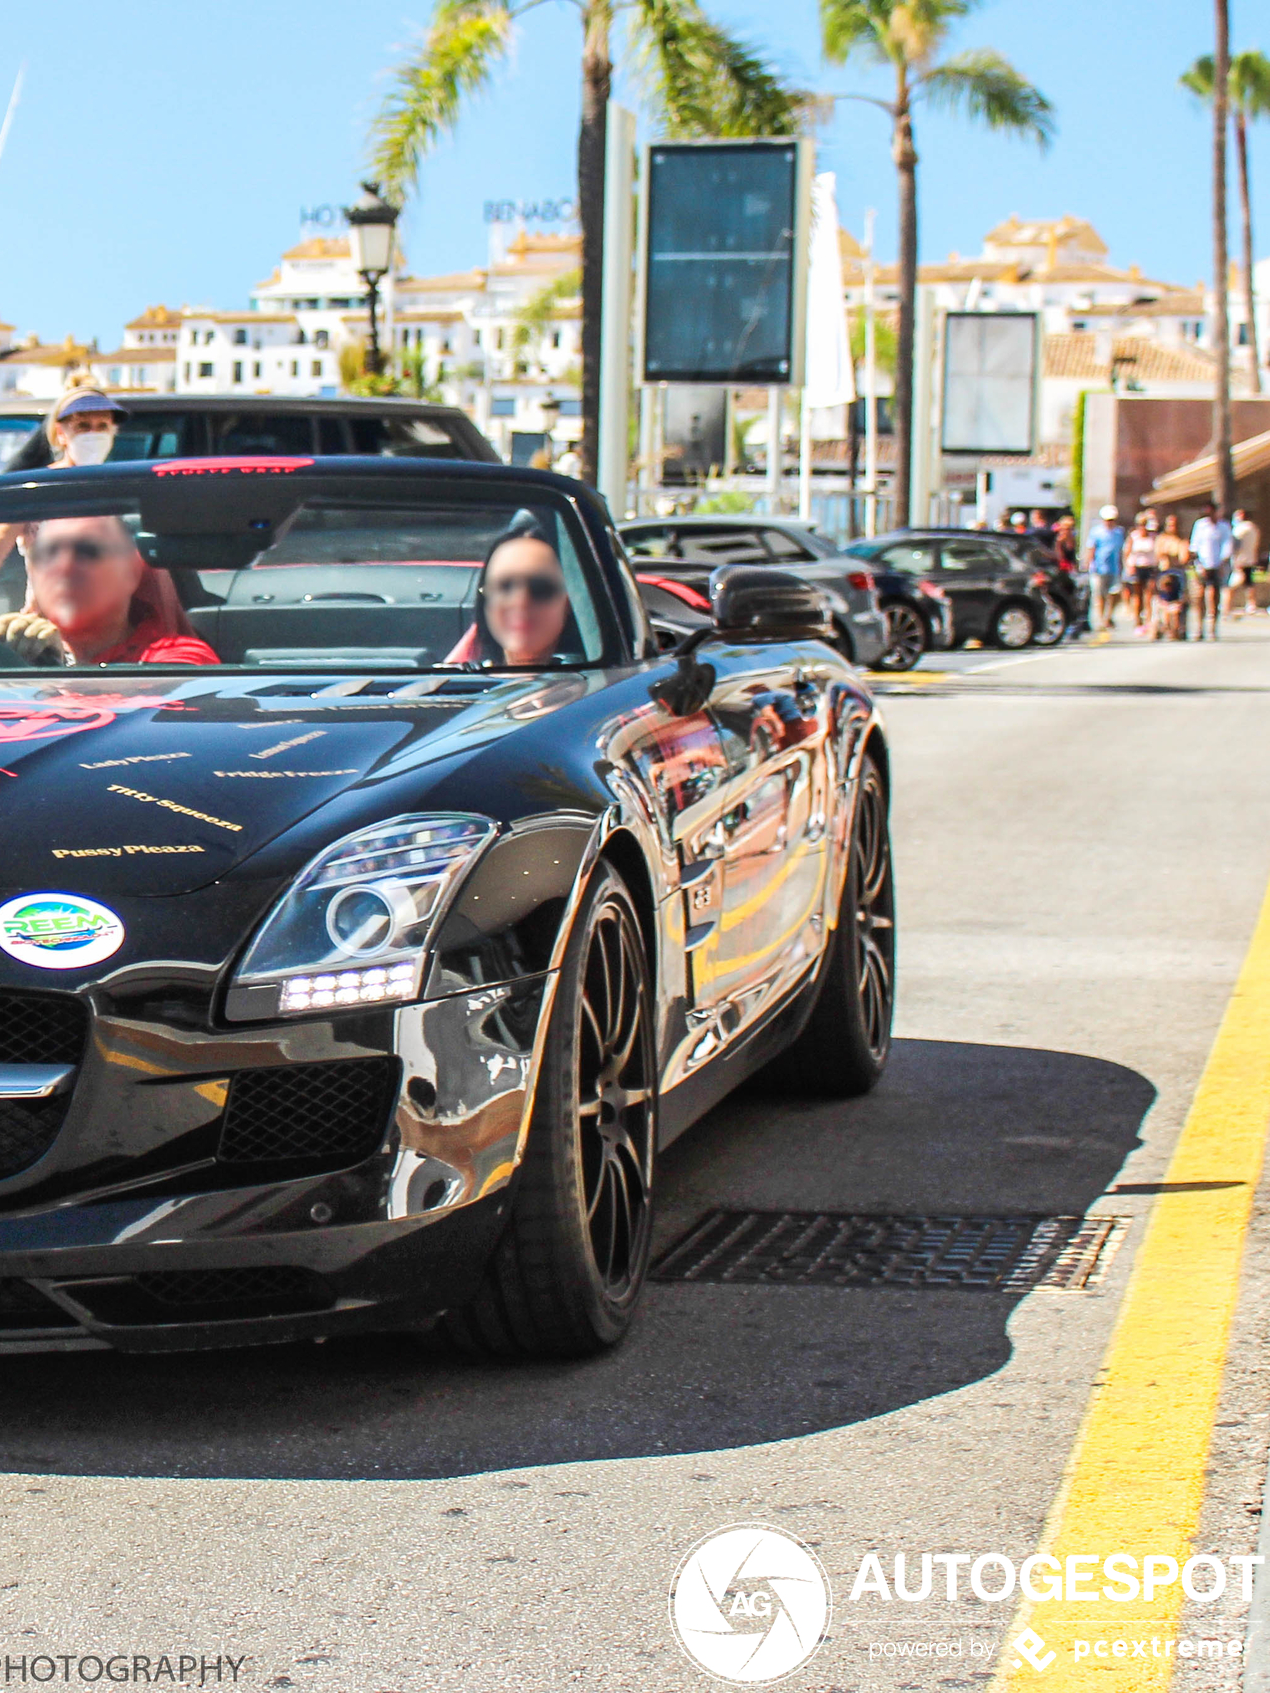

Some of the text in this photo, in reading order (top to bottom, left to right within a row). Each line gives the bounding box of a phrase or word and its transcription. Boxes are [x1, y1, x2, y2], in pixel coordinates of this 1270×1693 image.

[483, 198, 578, 223] BENABO
[155, 799, 244, 833] Squeeza
[51, 843, 206, 860] Pussy Pleaza
[2, 914, 111, 934] REEM
